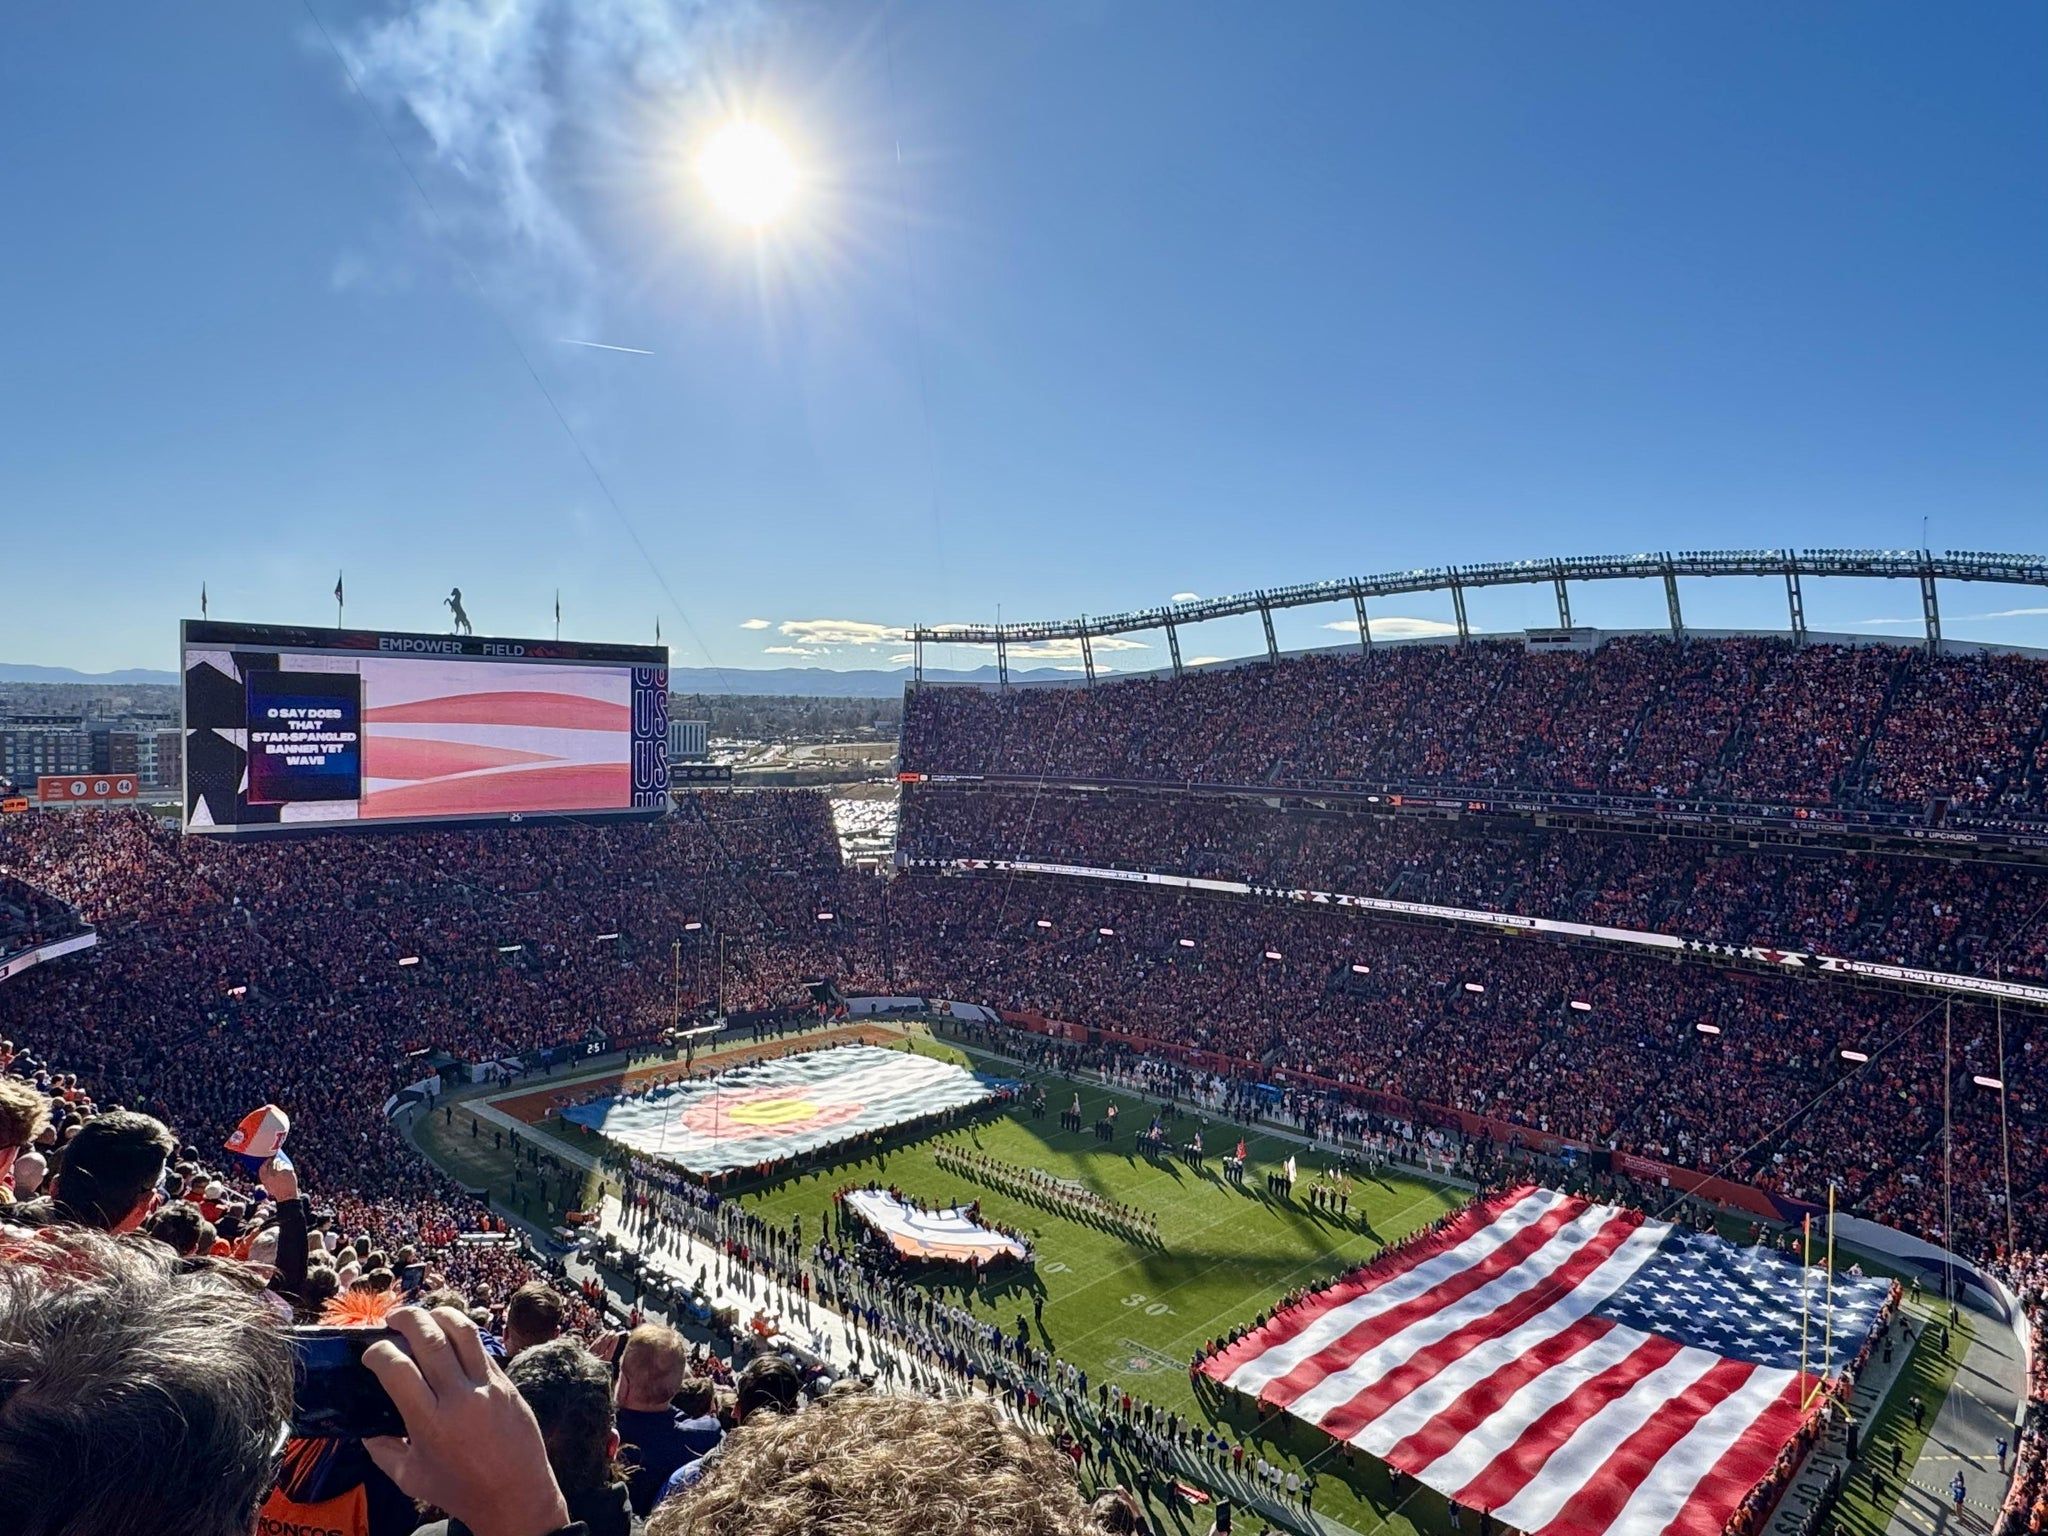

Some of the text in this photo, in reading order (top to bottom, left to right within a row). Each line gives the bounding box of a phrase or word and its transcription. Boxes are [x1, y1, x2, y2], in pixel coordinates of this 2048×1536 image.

[379, 638, 525, 656] EMPOWER FIELD
[268, 709, 342, 718] O SAY DOES
[635, 690, 668, 738] US
[288, 721, 323, 730] THAT
[252, 732, 356, 742] STAR-SPANGLED
[266, 744, 344, 754] BANNER YET
[286, 756, 325, 765] WAVE
[635, 741, 668, 789] US
[75, 784, 82, 793] 7
[119, 781, 130, 791] 44
[1929, 832, 1978, 842] UPCHURCH
[1121, 1293, 1169, 1316] 30
